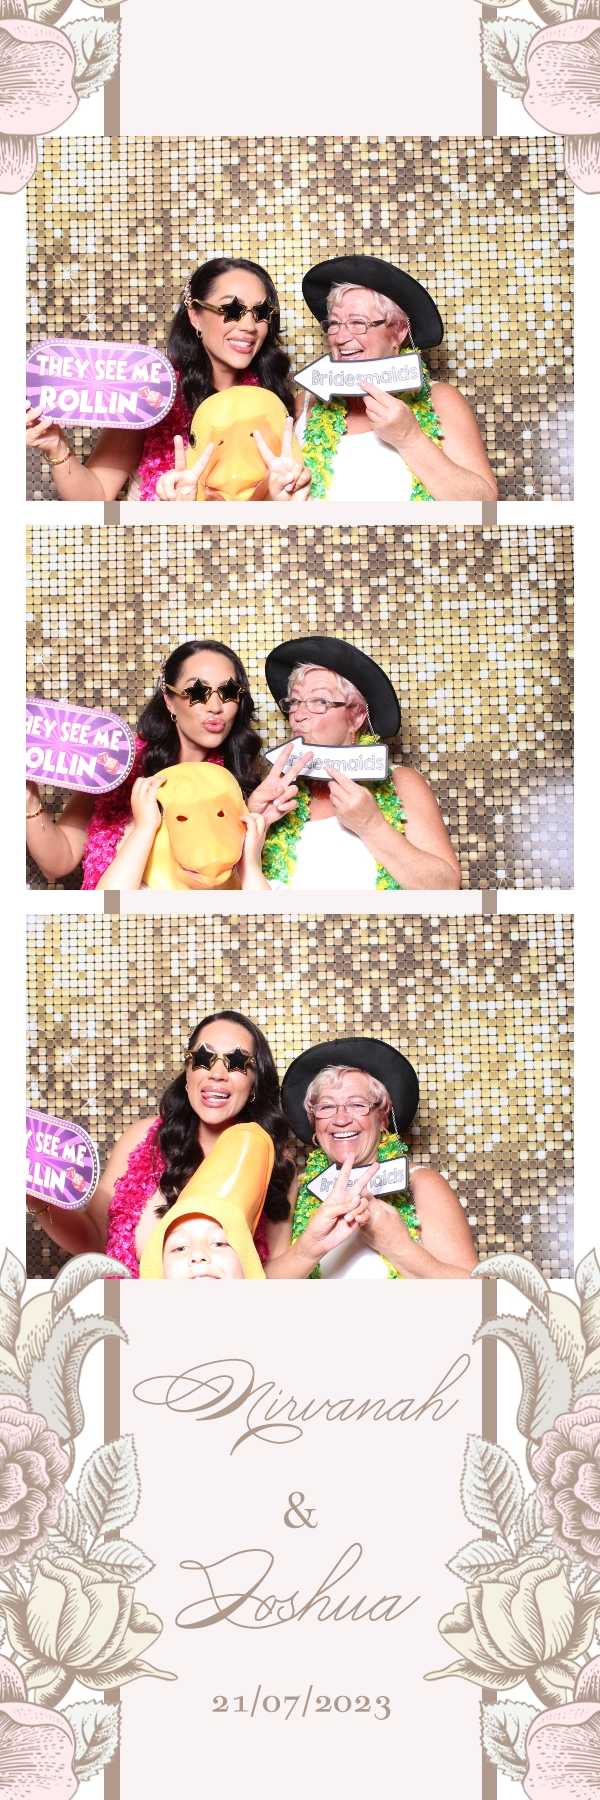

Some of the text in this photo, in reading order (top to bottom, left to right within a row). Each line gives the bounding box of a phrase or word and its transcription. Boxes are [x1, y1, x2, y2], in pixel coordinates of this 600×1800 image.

[36, 354, 162, 384] THEY SEE ME
[311, 364, 419, 387] Bridesmaids
[39, 385, 139, 415] ROLLIN
[26, 715, 123, 752] HEY SEE ME
[26, 746, 98, 779] OLLIN
[284, 752, 385, 772] resmaids
[35, 1131, 61, 1158] SEE
[62, 1140, 87, 1168] ME
[26, 1158, 67, 1194] LLIN
[319, 1168, 405, 1192] Breaids
